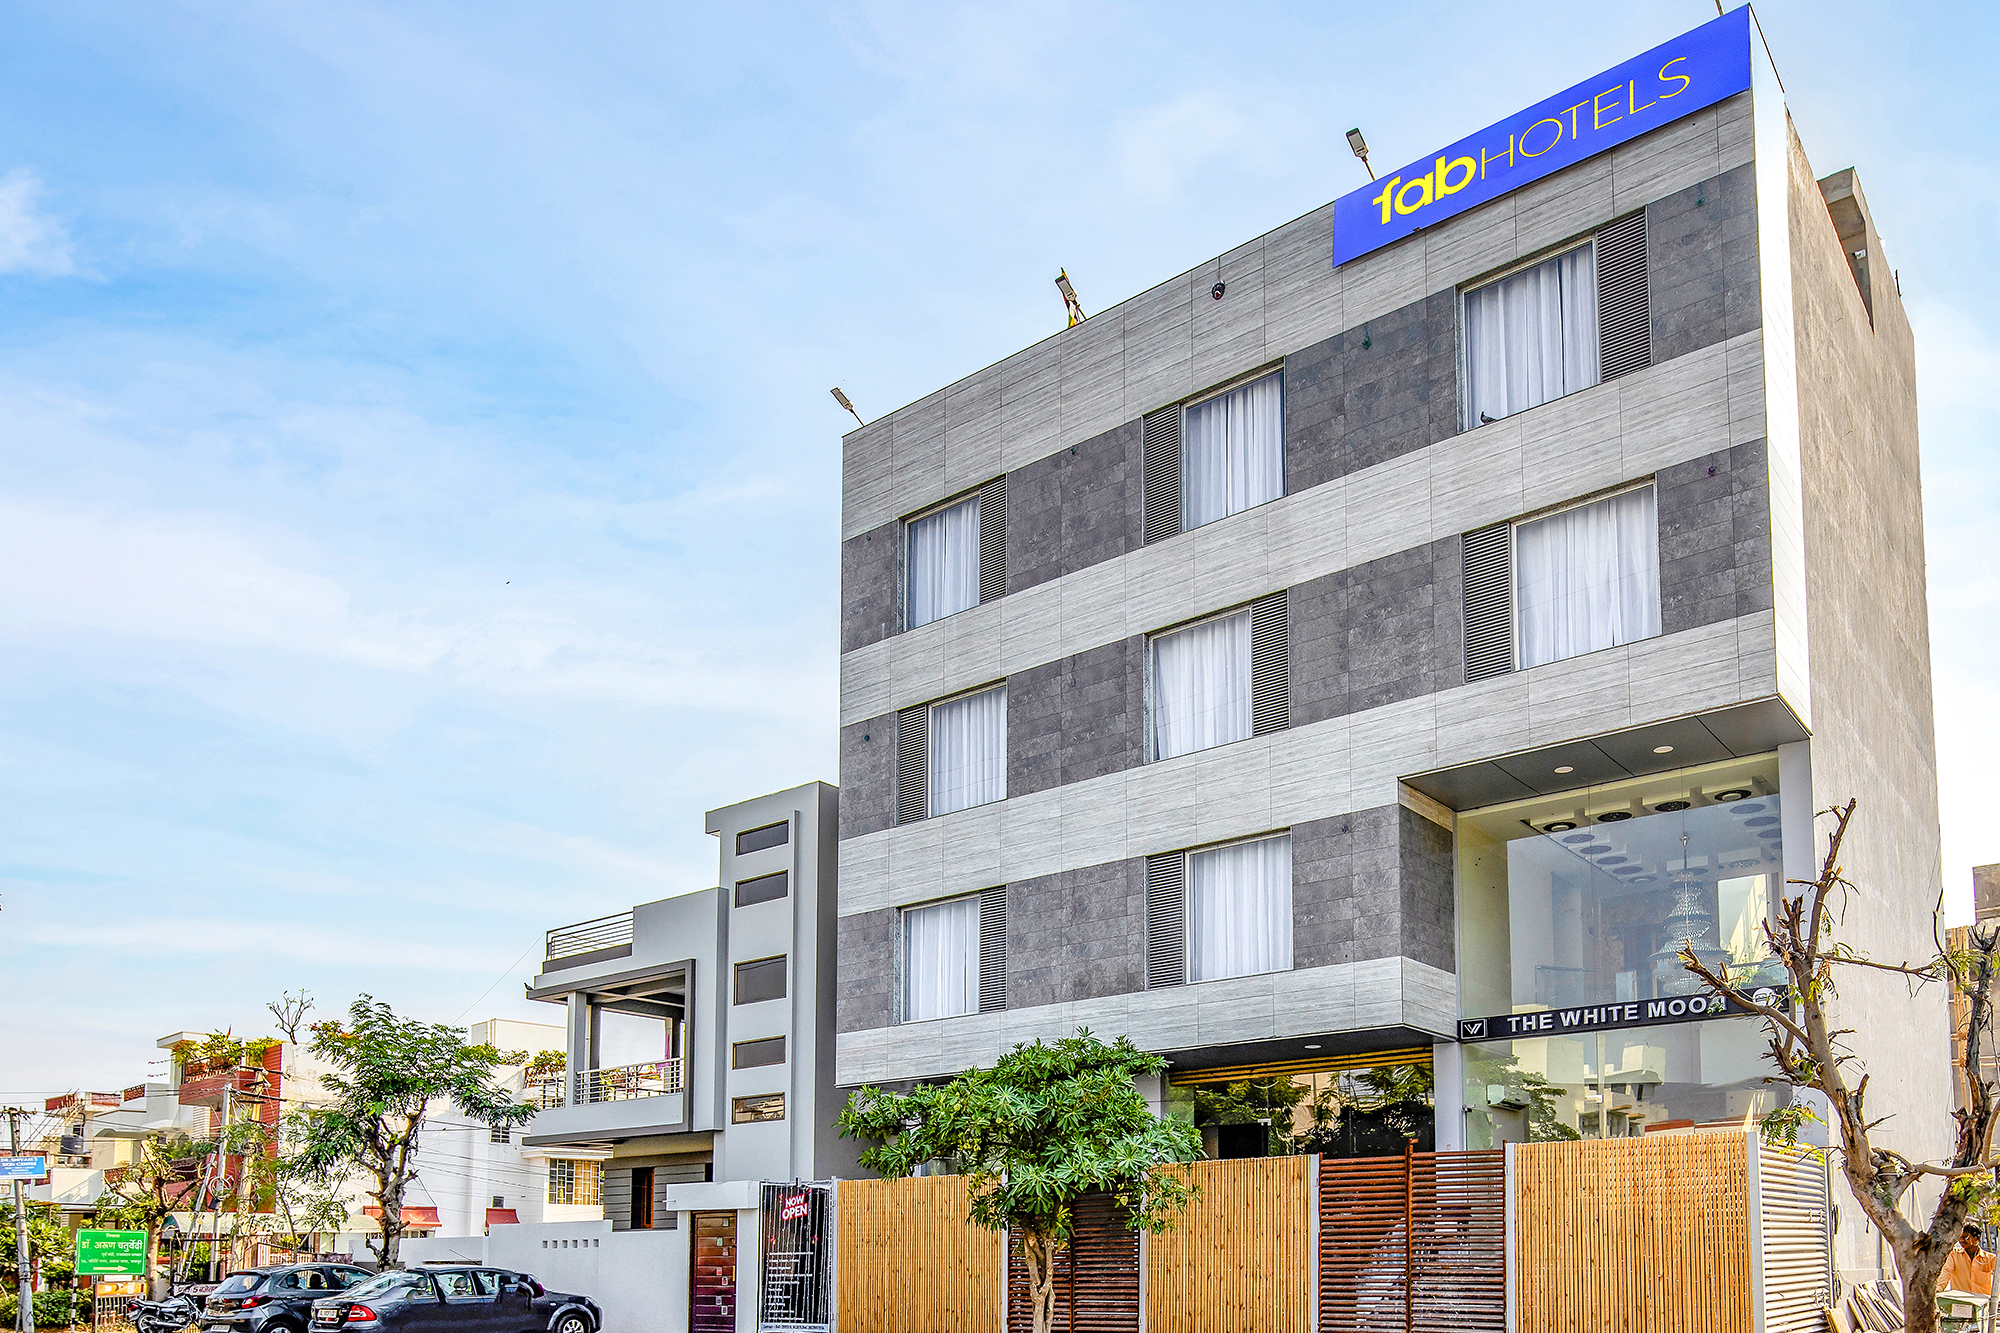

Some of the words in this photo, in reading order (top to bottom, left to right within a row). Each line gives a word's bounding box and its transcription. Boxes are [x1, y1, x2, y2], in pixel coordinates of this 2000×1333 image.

[1507, 1013, 1554, 1033] THE
[1560, 1004, 1639, 1027] WHITE
[785, 1194, 805, 1208] NOW
[782, 1203, 808, 1220] OPEN
